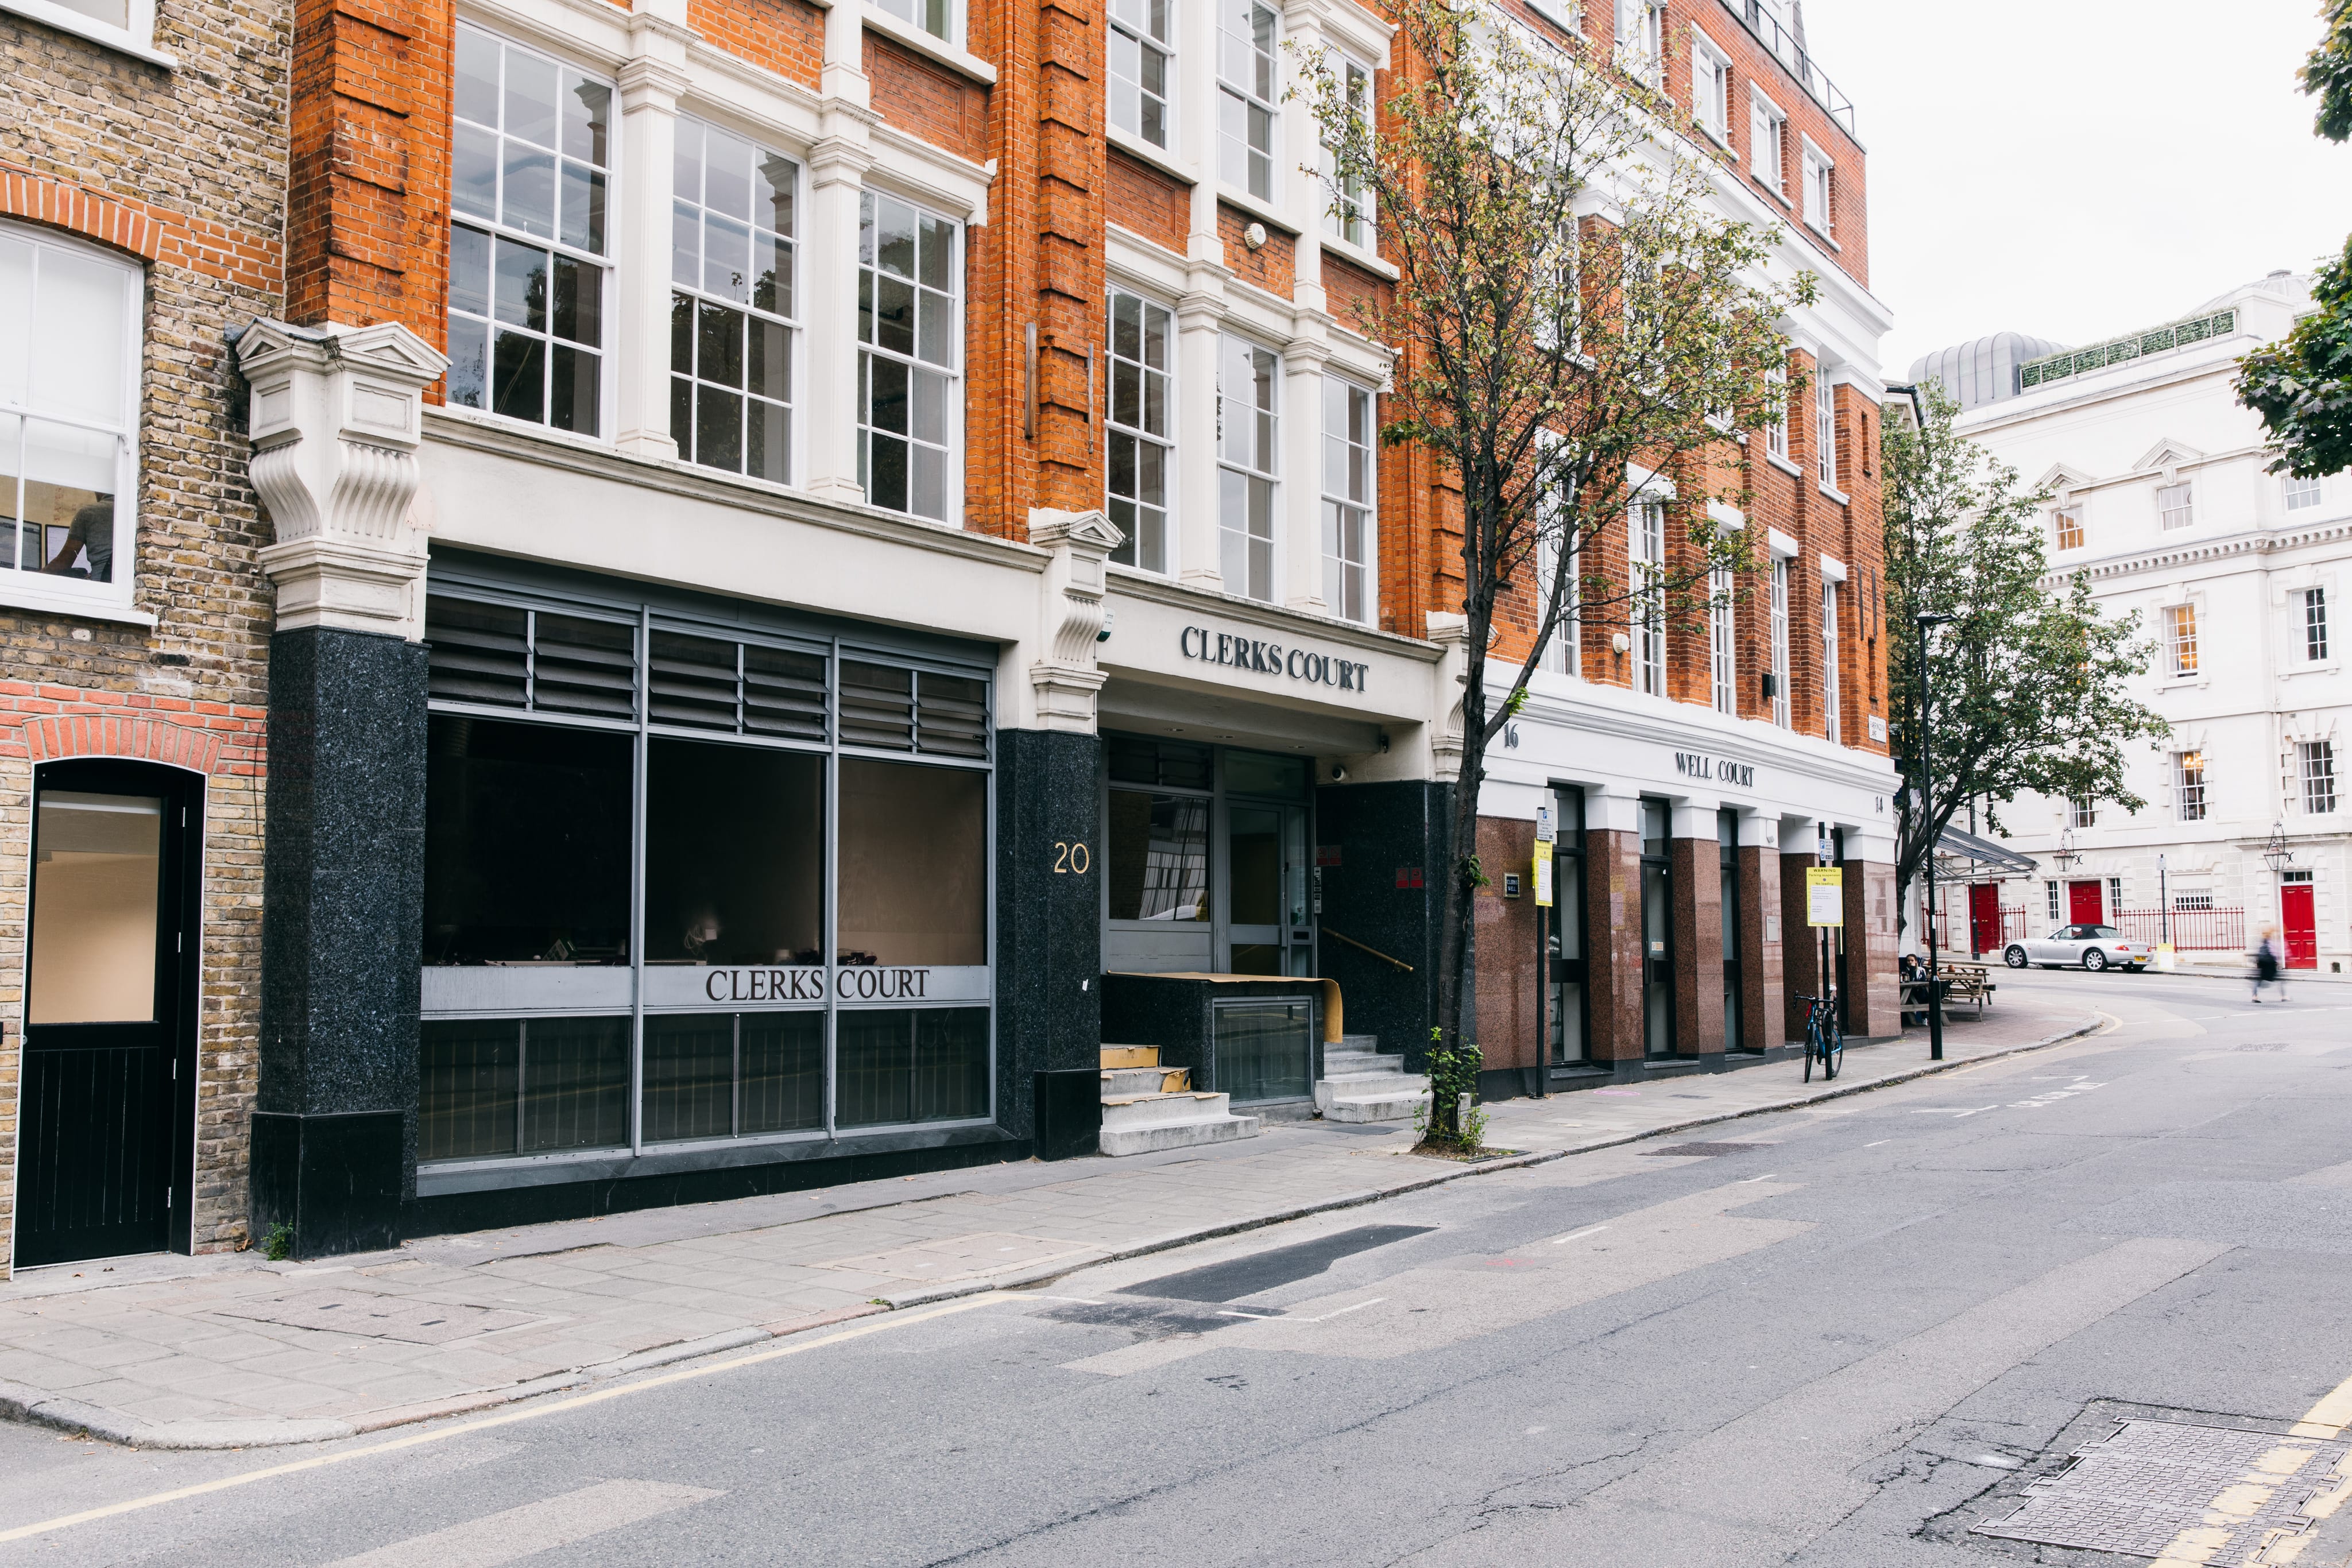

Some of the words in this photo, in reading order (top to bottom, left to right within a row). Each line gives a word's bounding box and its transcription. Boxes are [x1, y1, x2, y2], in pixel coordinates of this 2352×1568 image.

[1181, 626, 1282, 675] CLERKS
[1288, 649, 1368, 692] COURT
[1504, 722, 1519, 749] 16
[1676, 752, 1712, 779] WELL
[1719, 760, 1755, 787] COURT
[1875, 795, 1883, 814] 14
[1054, 842, 1089, 874] 20
[706, 970, 823, 1001] CLERKS
[837, 969, 930, 998] COURT
